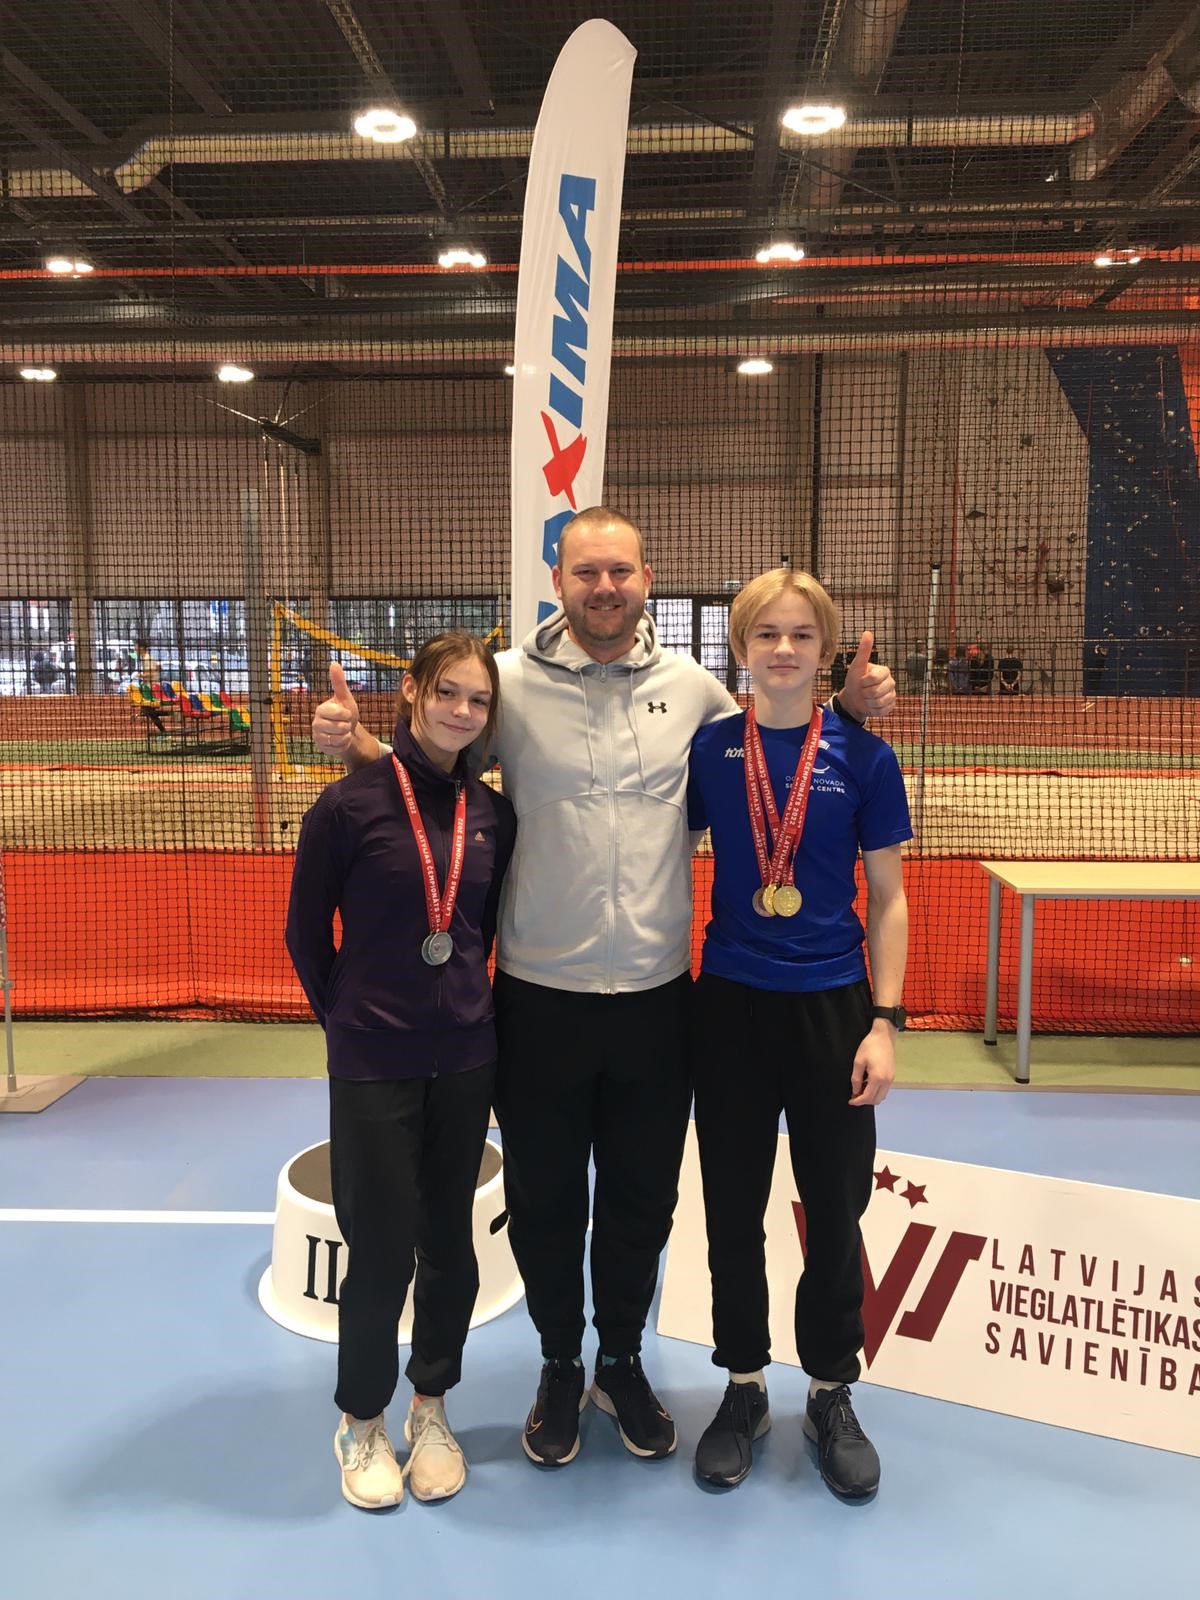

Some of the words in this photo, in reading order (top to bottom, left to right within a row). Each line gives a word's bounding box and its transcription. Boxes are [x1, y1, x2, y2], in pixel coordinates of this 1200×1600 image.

[537, 173, 596, 625] XIMA
[807, 728, 818, 760] LATVIJAS
[750, 782, 761, 817] LATVIJAS
[762, 780, 775, 814] LATVIJAS
[813, 778, 845, 787] NOVADA
[816, 785, 846, 794] CENTRS
[406, 797, 417, 814] 2022
[789, 807, 799, 825] 2022
[417, 829, 431, 864] LATVIJAS
[445, 881, 457, 917] LATVIJAS
[989, 1279, 1200, 1352] VIEGLATLĒTIKAS
[984, 1321, 1200, 1397] SAVIENĪBA
